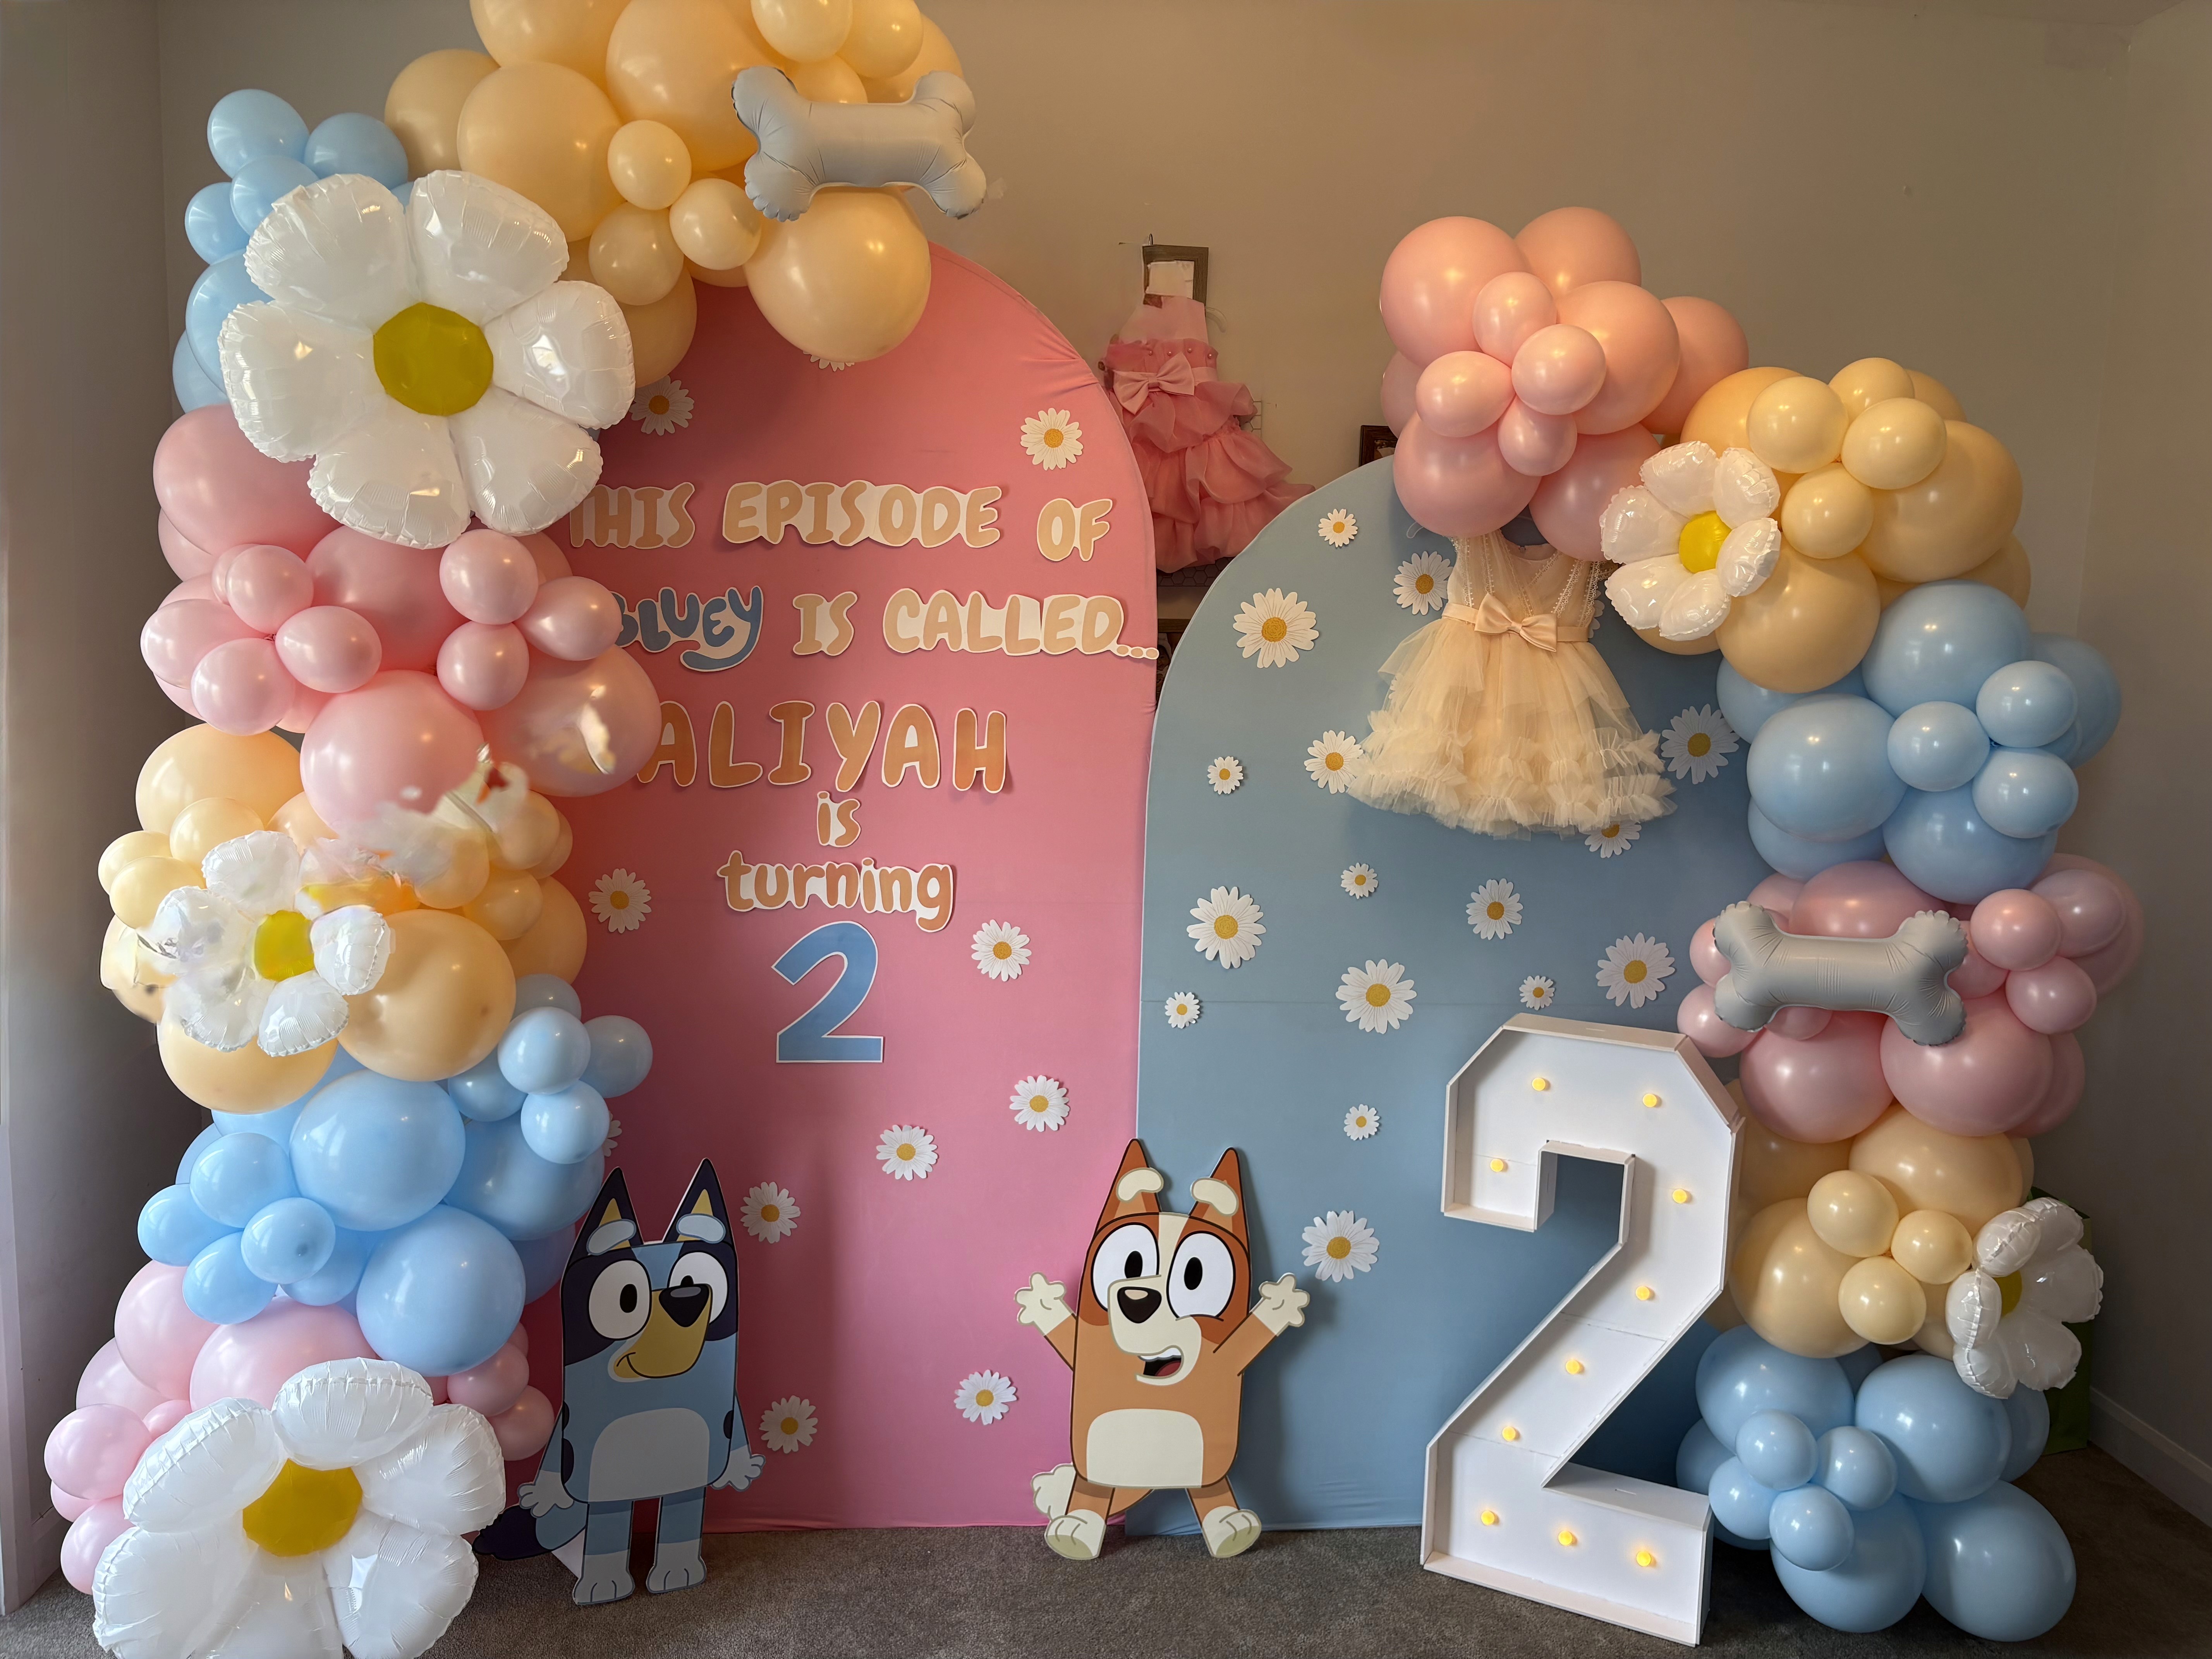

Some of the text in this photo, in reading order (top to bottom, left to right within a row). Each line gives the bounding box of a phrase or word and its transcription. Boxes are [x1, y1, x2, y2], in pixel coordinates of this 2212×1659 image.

[570, 481, 1113, 561] THIS EPISODE OF
[793, 592, 857, 655] IS
[883, 588, 1159, 659] CALLED...
[637, 701, 1006, 793] ALIYAH
[817, 791, 861, 847] is
[717, 850, 953, 932] turning
[772, 921, 884, 1063] 2
[1420, 1012, 1745, 1646] 2
